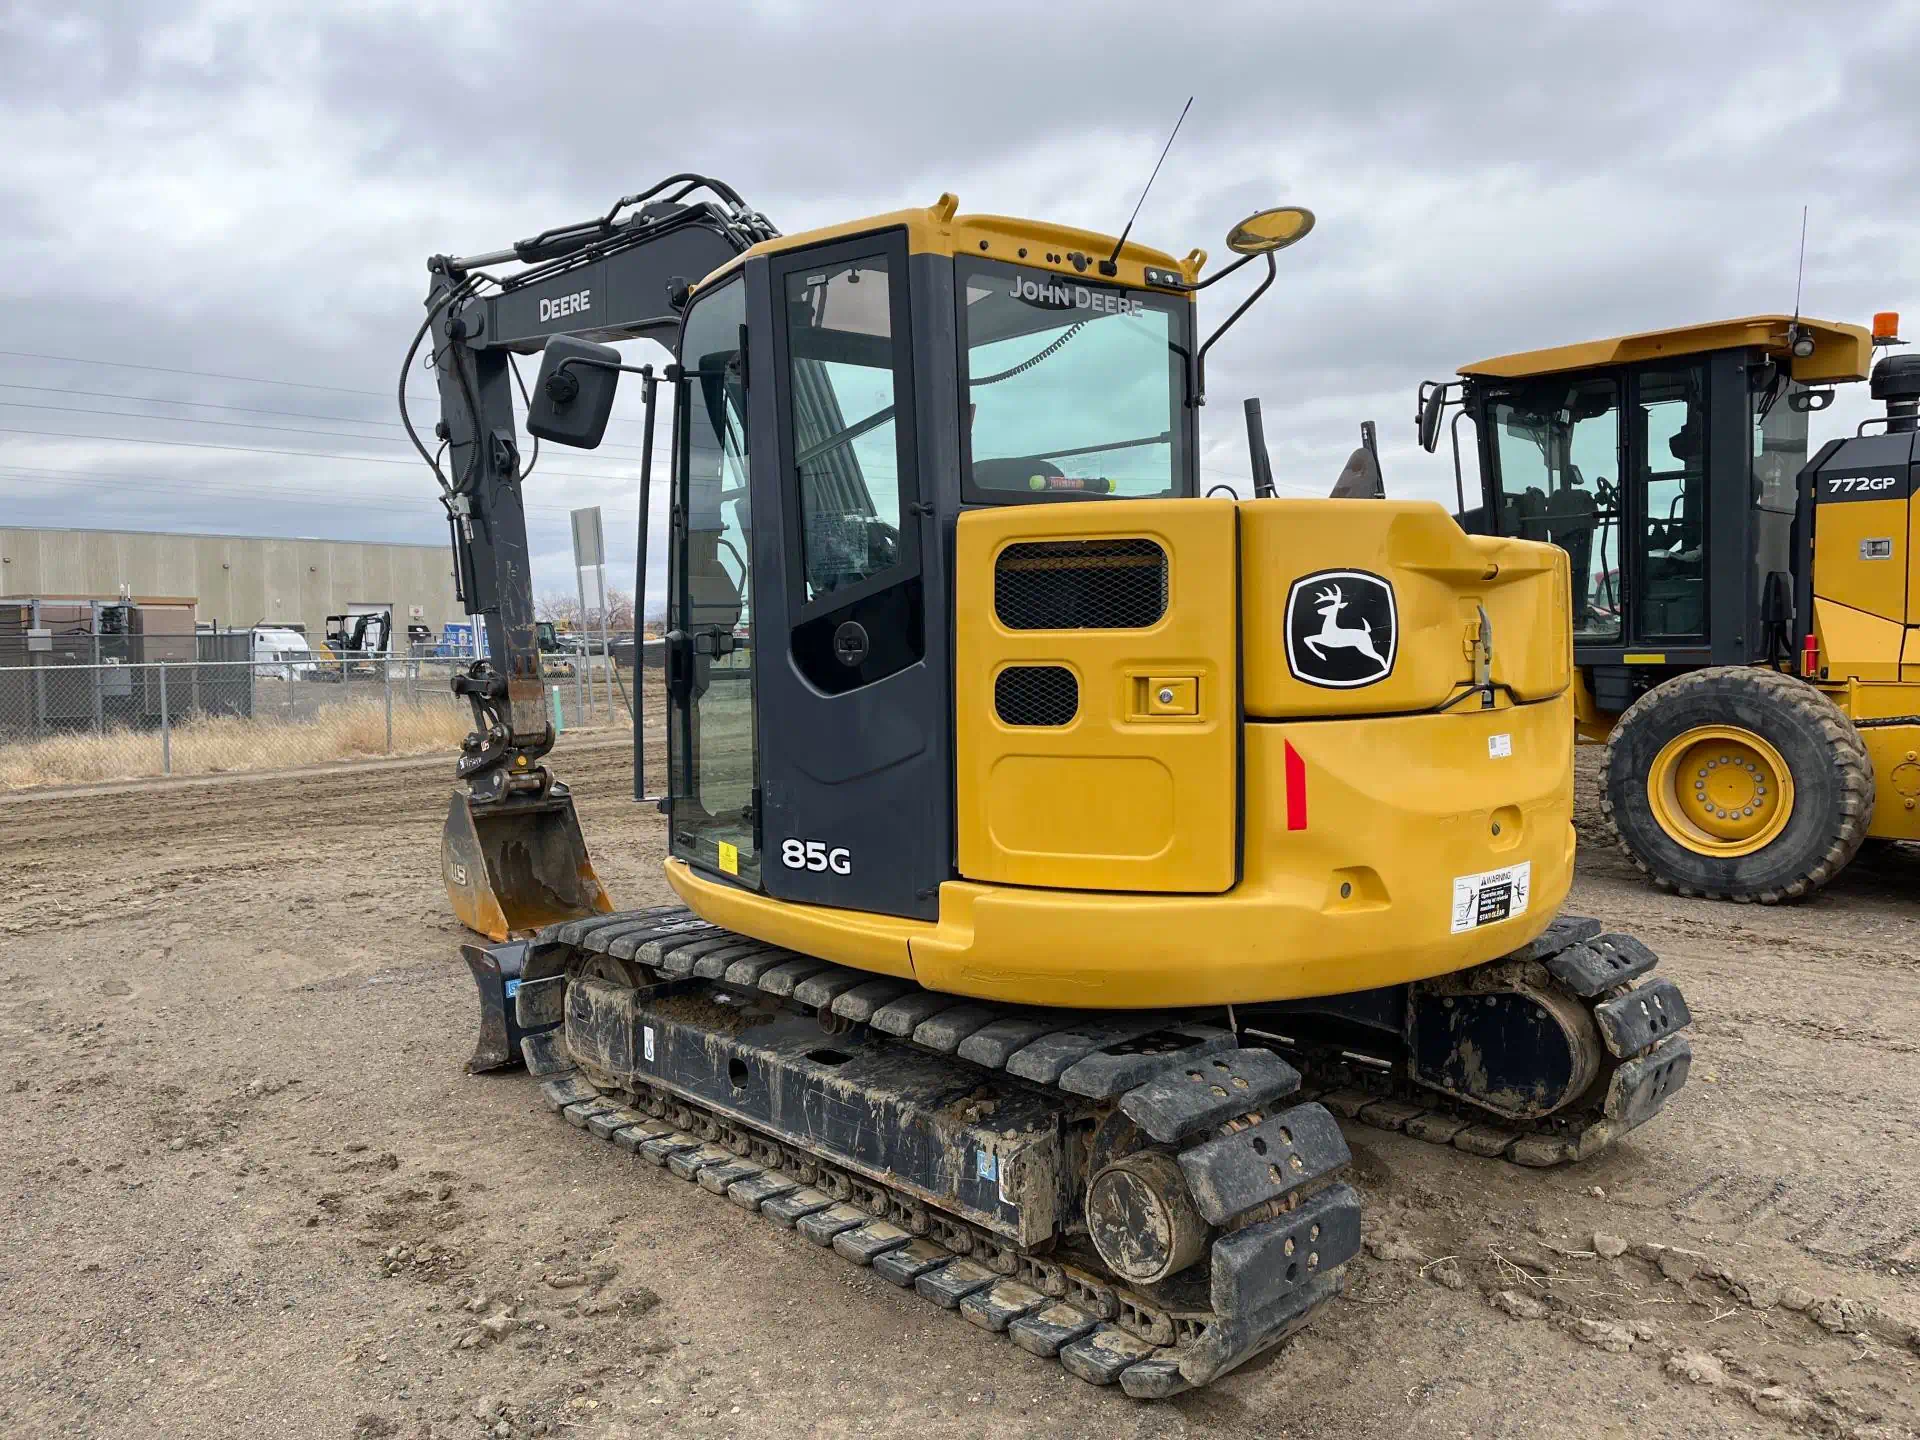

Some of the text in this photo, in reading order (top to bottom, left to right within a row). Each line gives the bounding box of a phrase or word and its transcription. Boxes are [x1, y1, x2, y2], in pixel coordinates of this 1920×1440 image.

[539, 289, 591, 323] DEERE
[1009, 275, 1143, 318] JOHN DEERE
[1828, 476, 1896, 493] 772GP
[781, 838, 851, 875] 85G
[1487, 871, 1511, 884] WARNING
